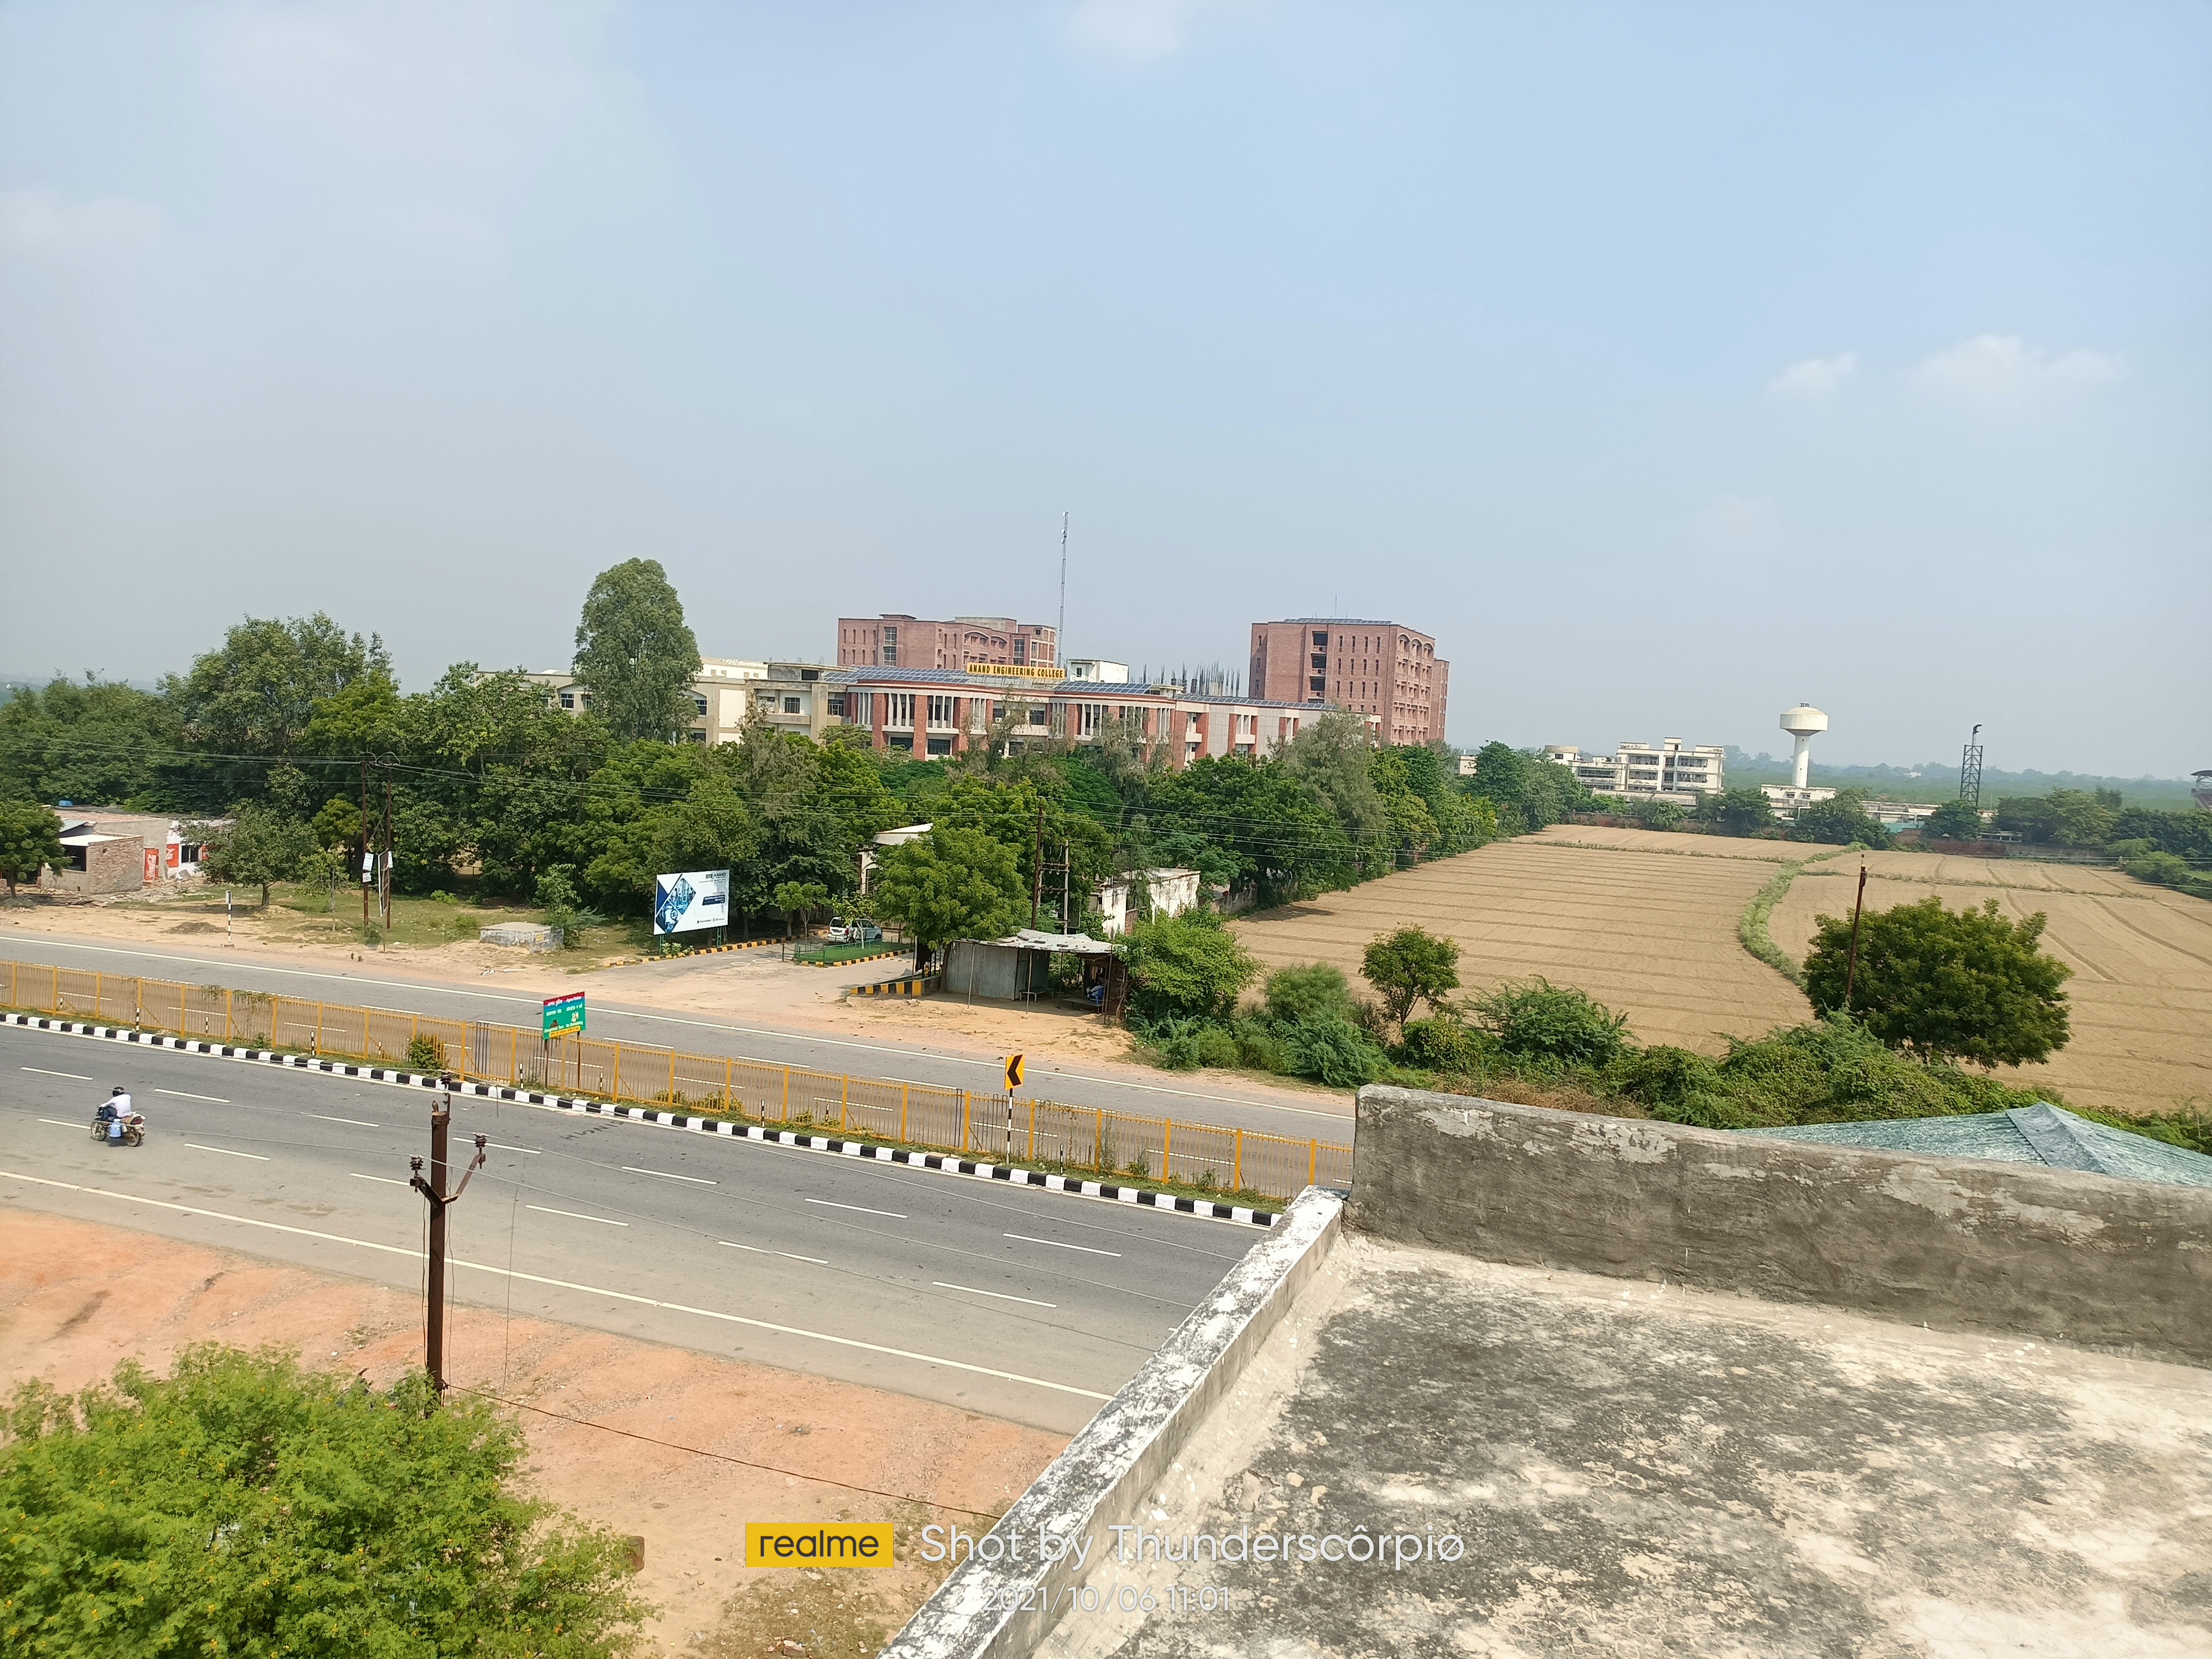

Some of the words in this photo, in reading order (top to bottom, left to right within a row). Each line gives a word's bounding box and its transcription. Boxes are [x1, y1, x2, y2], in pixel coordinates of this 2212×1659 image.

[969, 664, 990, 674] ANAND
[993, 666, 1034, 676] ENGINEERING
[1037, 669, 1063, 678] COLLEGE
